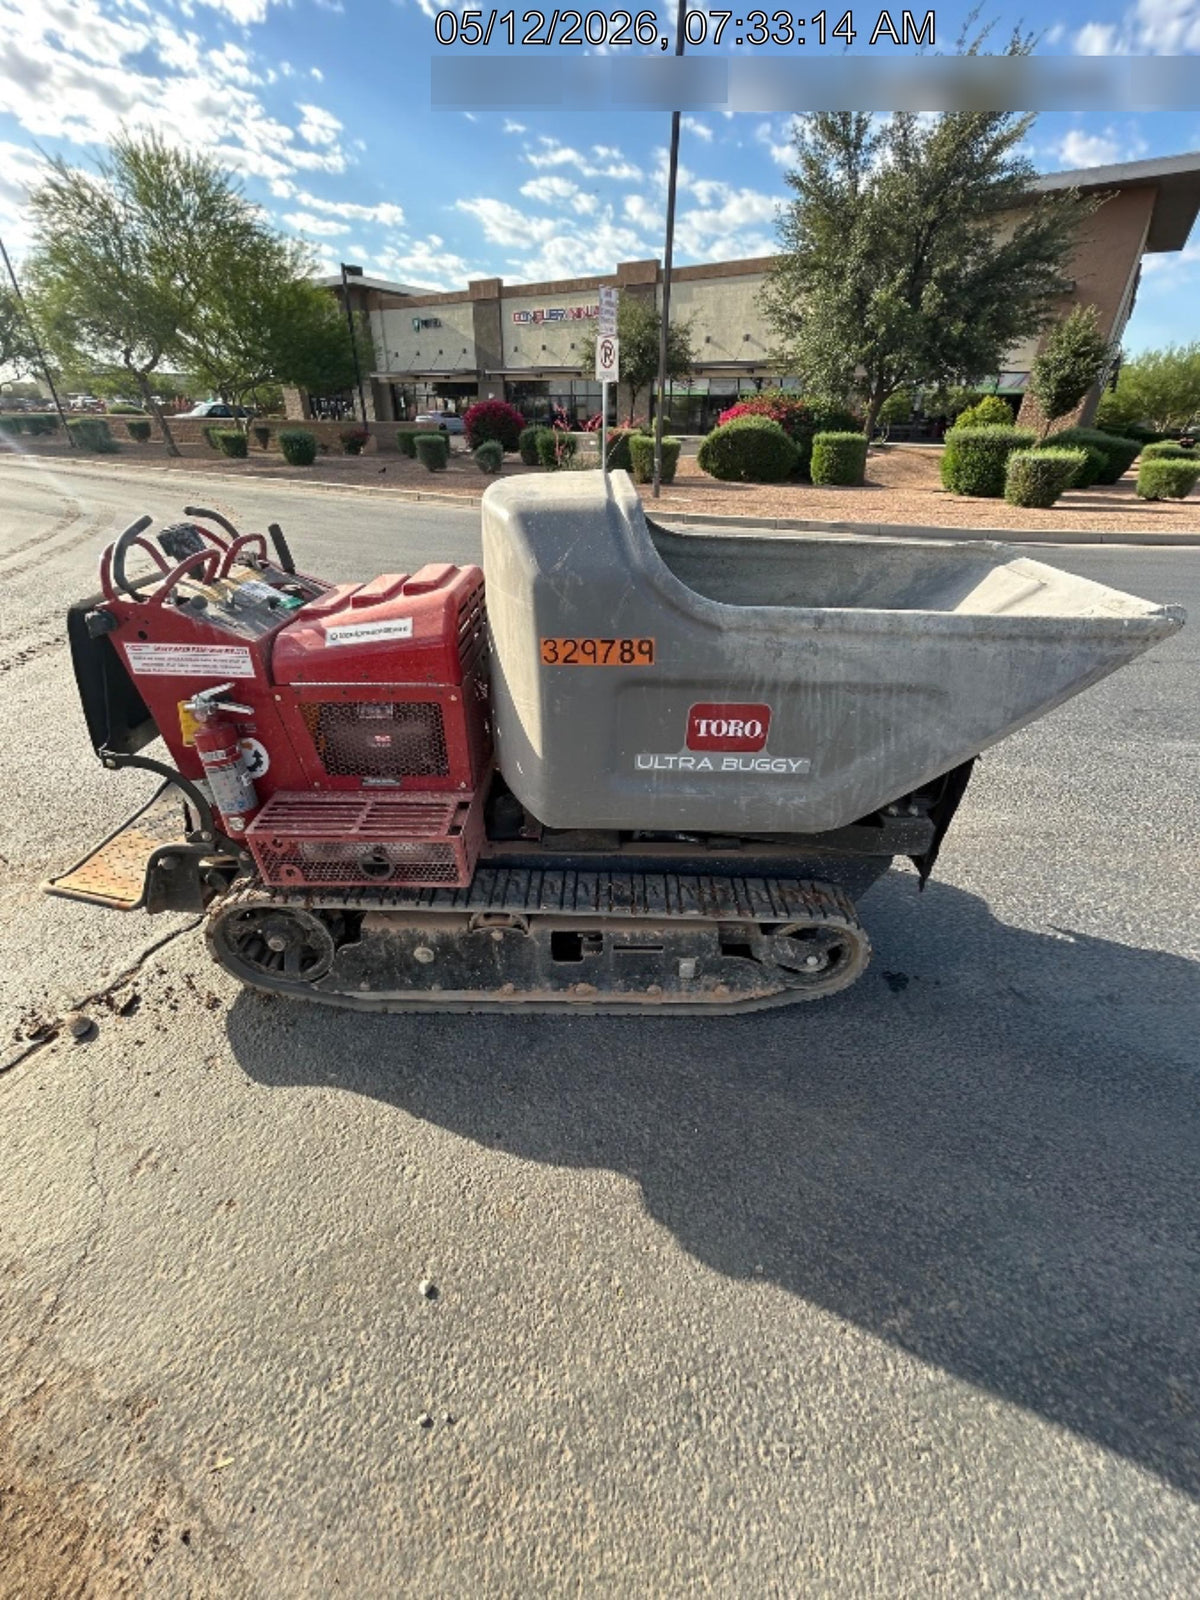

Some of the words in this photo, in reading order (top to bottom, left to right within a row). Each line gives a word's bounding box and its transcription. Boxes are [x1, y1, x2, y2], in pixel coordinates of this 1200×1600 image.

[543, 639, 654, 664] 329789
[695, 719, 764, 738] TORO
[636, 756, 714, 770] ULTRA
[721, 758, 802, 772] BUGGY
